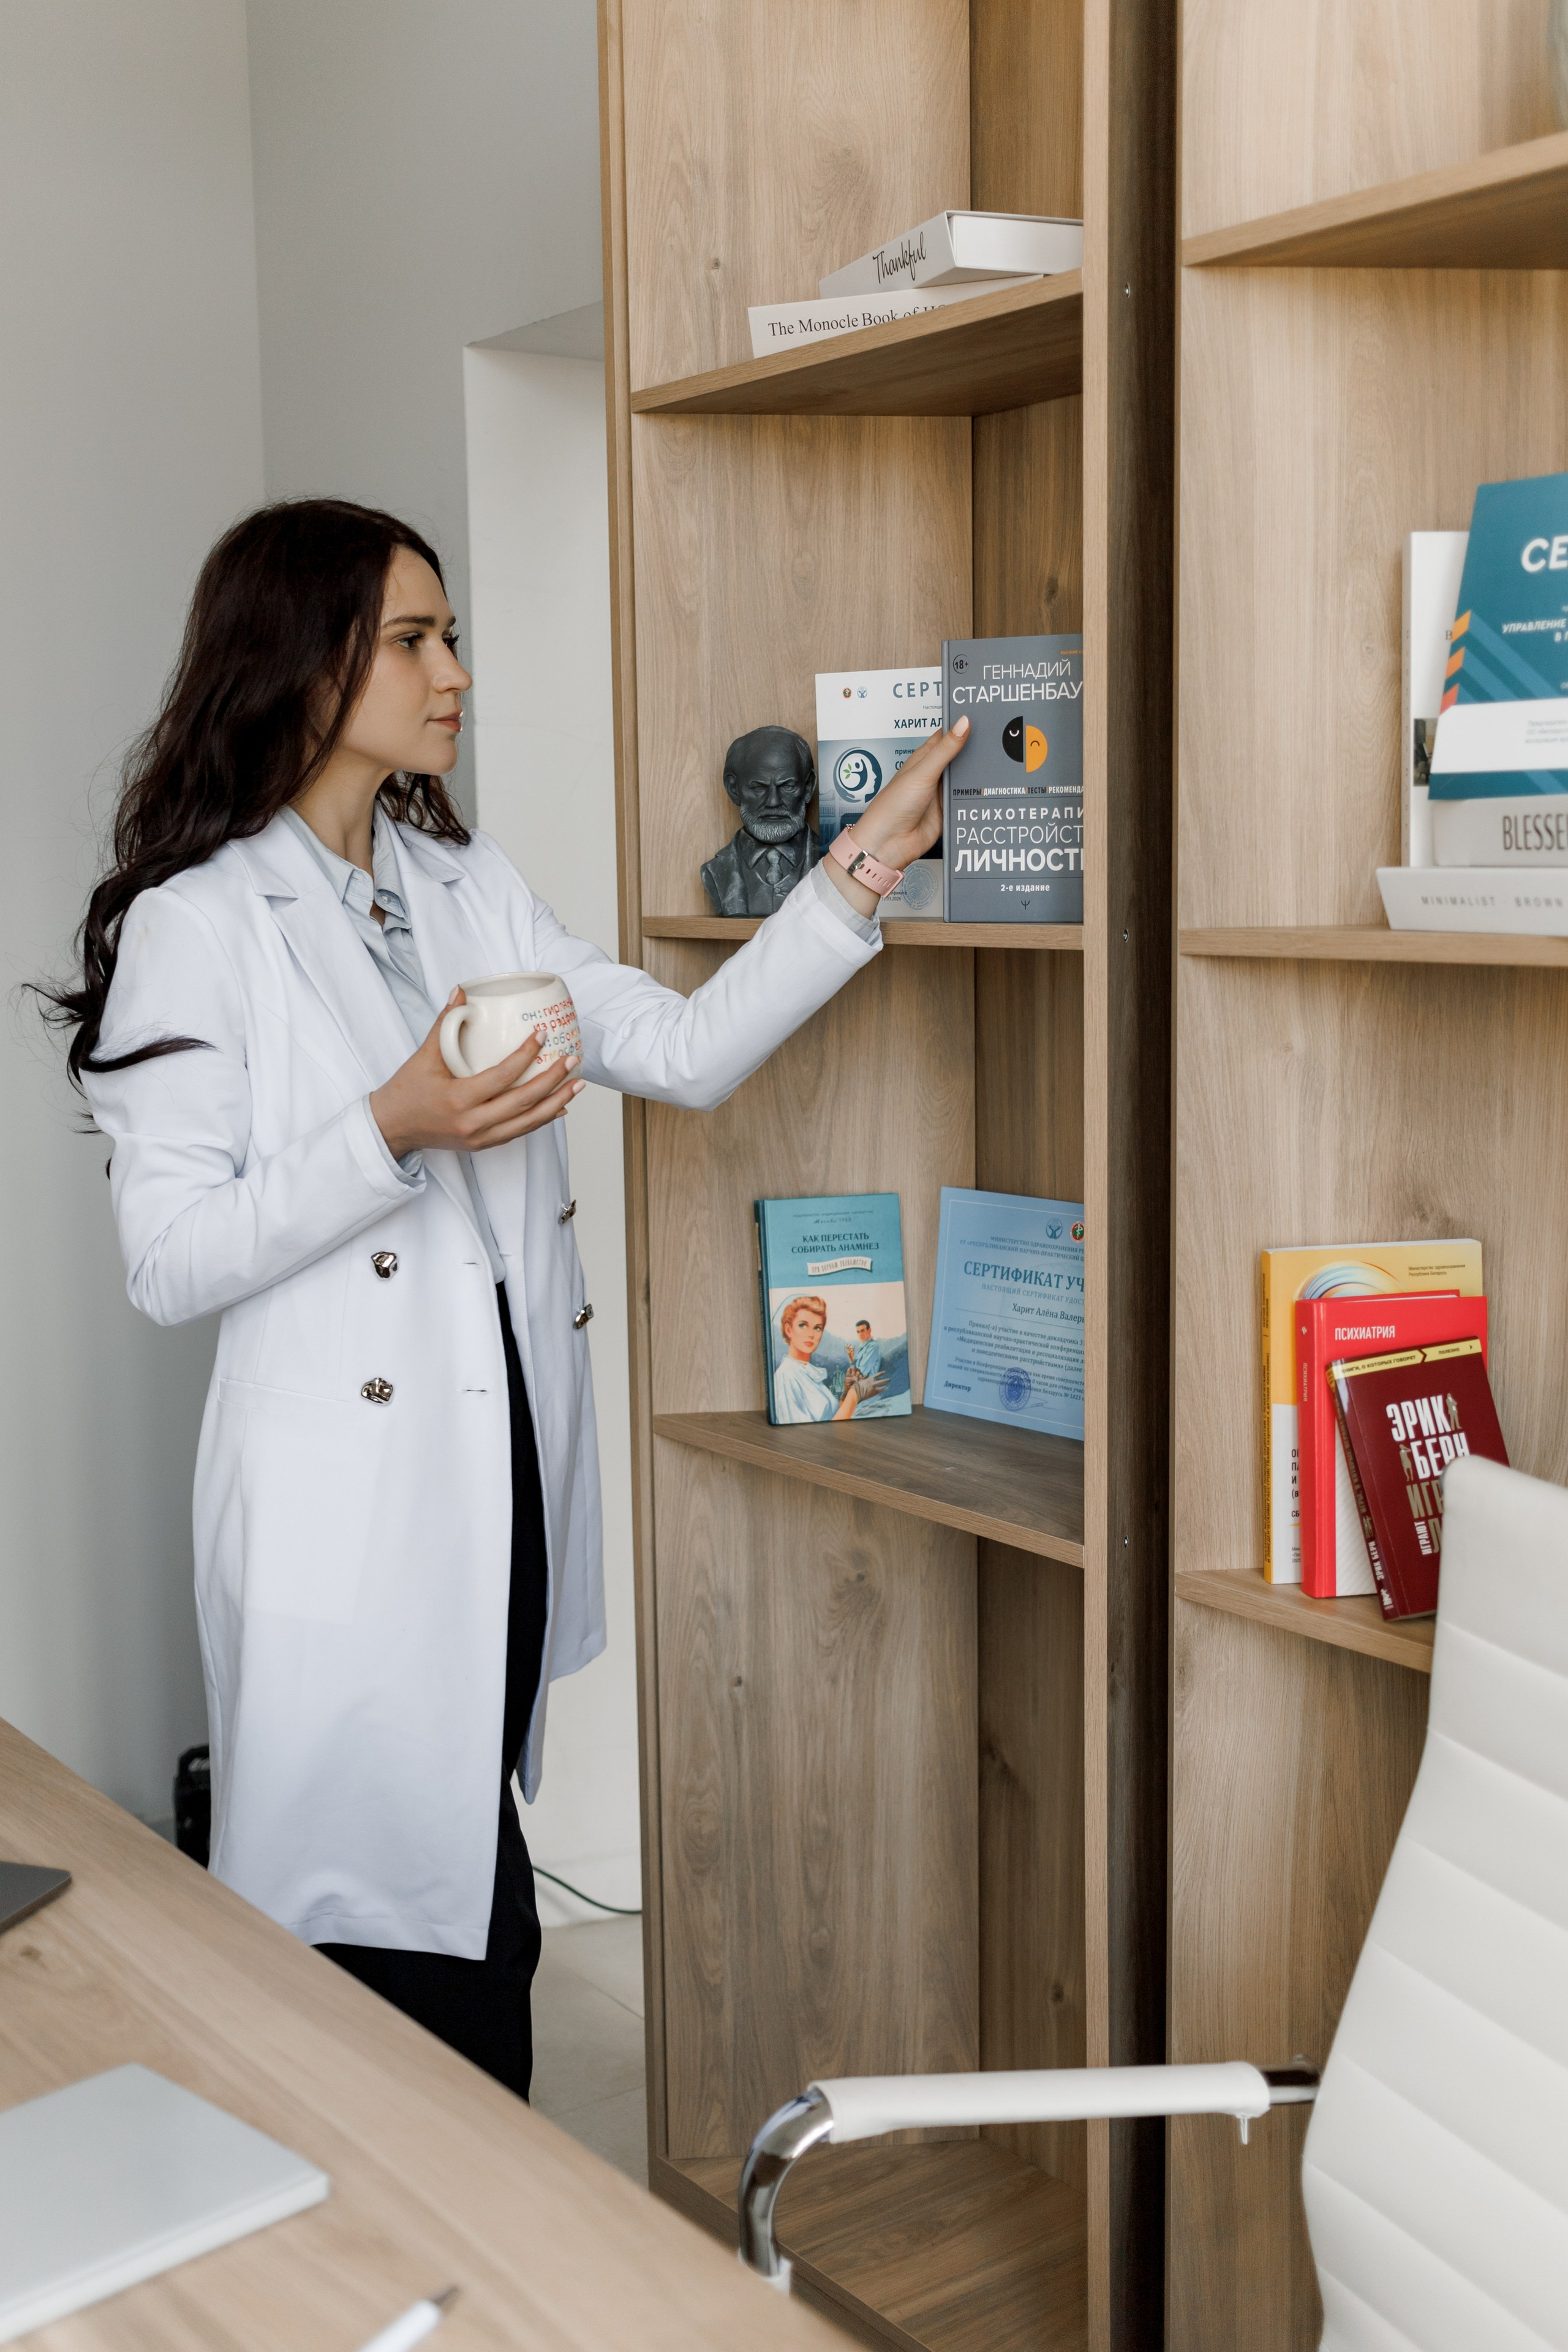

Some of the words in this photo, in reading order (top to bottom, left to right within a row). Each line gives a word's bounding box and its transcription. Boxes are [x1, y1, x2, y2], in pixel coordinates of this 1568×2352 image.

[872, 232, 927, 284] Thankful
[768, 322, 794, 336] The
[797, 314, 858, 333] Monocle
[861, 309, 898, 326] Book
[1520, 534, 1568, 573] СЕ
[1502, 618, 1567, 634] УПРАВЛЕНИЕ
[954, 660, 969, 669] 18+
[983, 658, 1071, 680] ГЕННАДИЙ
[952, 681, 1084, 704] СТАРШЕНБАУ
[894, 718, 927, 729] ХАРИТ
[957, 807, 1084, 821] ПСИХОТЕРАПИ
[956, 822, 1084, 845] РАССТРОЙСТ
[1502, 813, 1568, 851] BLESSE
[954, 848, 1084, 872] ЛИЧНОСТ
[1421, 896, 1496, 906] MINIMALIST
[802, 1234, 820, 1243] КАК
[821, 1232, 870, 1242] ПЕРЕСТАТЬ
[990, 1235, 1030, 1246] МИНИСТЕРСТВО
[1030, 1241, 1077, 1253] ЗДРАВООХРАНЕНИЯ
[791, 1244, 837, 1254] СОБИРАТЬ
[838, 1242, 880, 1252] АНАМНЕЗ
[963, 1261, 1063, 1289] СЕРТИФИКАТ
[982, 1283, 1020, 1295] НАСТОЯЩИЙ
[1022, 1289, 1063, 1302] СЕРТИФИКАТ
[1012, 1303, 1035, 1315] Харит
[1035, 1307, 1058, 1319] Алёна
[948, 1326, 993, 1338] республиканской
[993, 1334, 1049, 1349] научно-практической
[1023, 1331, 1046, 1340] качестве
[1047, 1335, 1079, 1345] докладчика
[1335, 1325, 1395, 1341] ПСИХИАТРИЯ
[1366, 1359, 1393, 1368] КОТОРЫХ
[1393, 1355, 1416, 1364] ГОВОРЯТ
[944, 1381, 971, 1393] Директор
[1385, 1395, 1452, 1442] ЭРИК
[1410, 1432, 1470, 1479] БЕРН
[1414, 1521, 1433, 1555] ИГРАЮТ
[1368, 1540, 1379, 1560] БЕРН
[1373, 1561, 1384, 1580] ЭРИК
